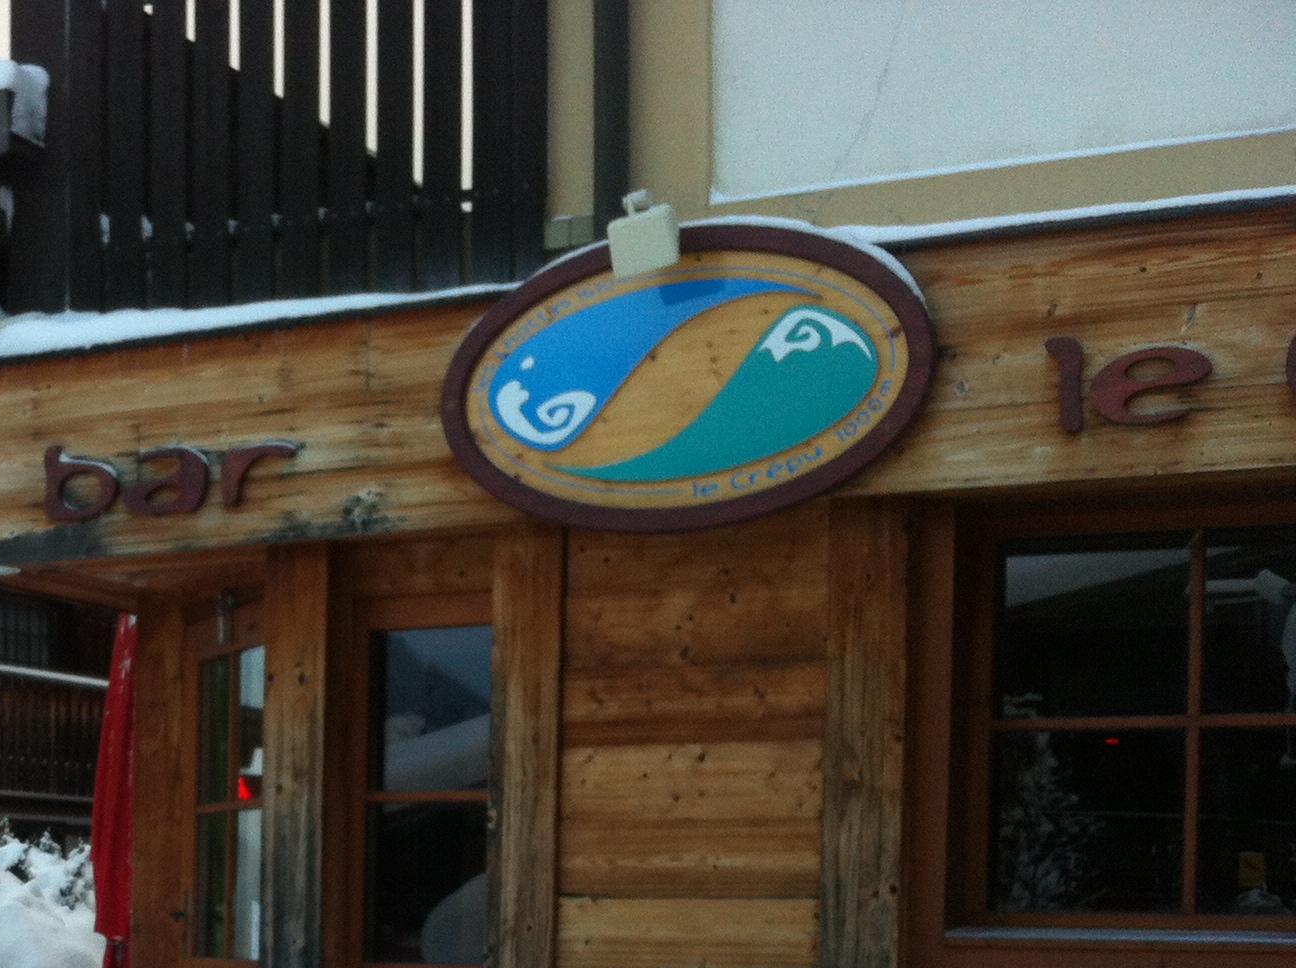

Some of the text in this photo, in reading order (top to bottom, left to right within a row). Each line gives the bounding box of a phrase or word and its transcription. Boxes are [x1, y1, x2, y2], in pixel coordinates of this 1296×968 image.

[1044, 336, 1213, 434] le
[44, 439, 303, 522] bar
[692, 481, 720, 498] le
